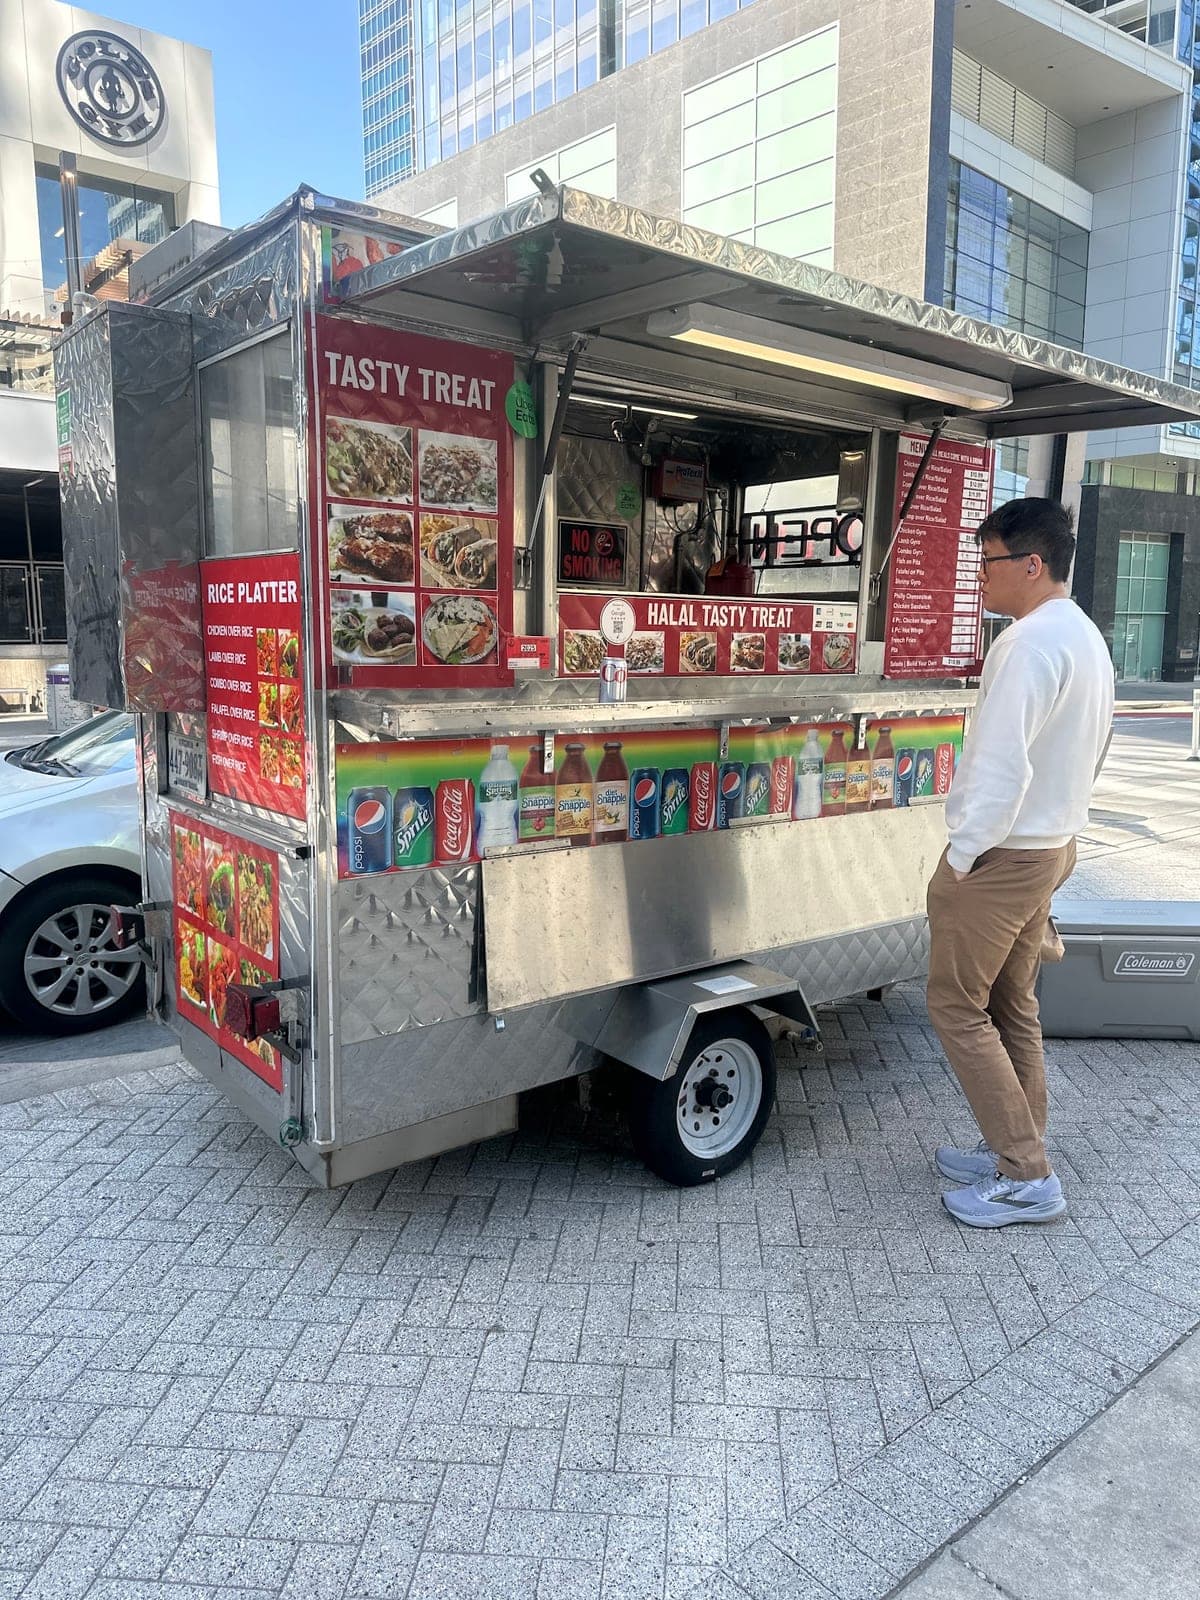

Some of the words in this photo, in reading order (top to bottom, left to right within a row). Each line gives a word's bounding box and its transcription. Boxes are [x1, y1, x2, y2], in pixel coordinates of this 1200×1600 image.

[324, 351, 410, 396] TASTY
[418, 368, 496, 411] TREAT
[572, 530, 590, 552] NO
[564, 555, 621, 580] SMOKING
[208, 583, 234, 604] RICE
[238, 580, 298, 603] PLATTER
[648, 603, 697, 626] HALAL
[702, 605, 748, 627] TASTY
[751, 606, 793, 628] TREAT
[208, 625, 227, 636] CHICKEN
[228, 625, 240, 637] OVER
[241, 626, 254, 637] RICE
[208, 652, 222, 662] LAMB
[222, 652, 234, 664] OVER
[235, 653, 246, 665] RICE
[210, 678, 226, 689] COMBO
[227, 679, 239, 691] OVER
[240, 681, 252, 693] RICE
[211, 703, 230, 717] FALAFEL
[230, 706, 243, 719] OVER
[243, 709, 255, 721] RICE
[212, 728, 228, 742] SHRIMP
[229, 732, 241, 745] OVER
[241, 735, 254, 748] RICE
[223, 756, 234, 769] OVER
[235, 760, 246, 772] RICE
[916, 764, 933, 794] Sprite
[522, 797, 555, 808] Snapple
[558, 800, 591, 812] Snapple
[597, 794, 626, 805] Snapple
[663, 788, 687, 824] Sprite
[695, 769, 710, 826] Coca-Cola
[747, 780, 768, 813] Sprite
[398, 808, 430, 854] Sprite
[443, 786, 463, 856] Coca-Cola
[354, 836, 365, 870] pepsi
[1124, 955, 1174, 968] Coleman
